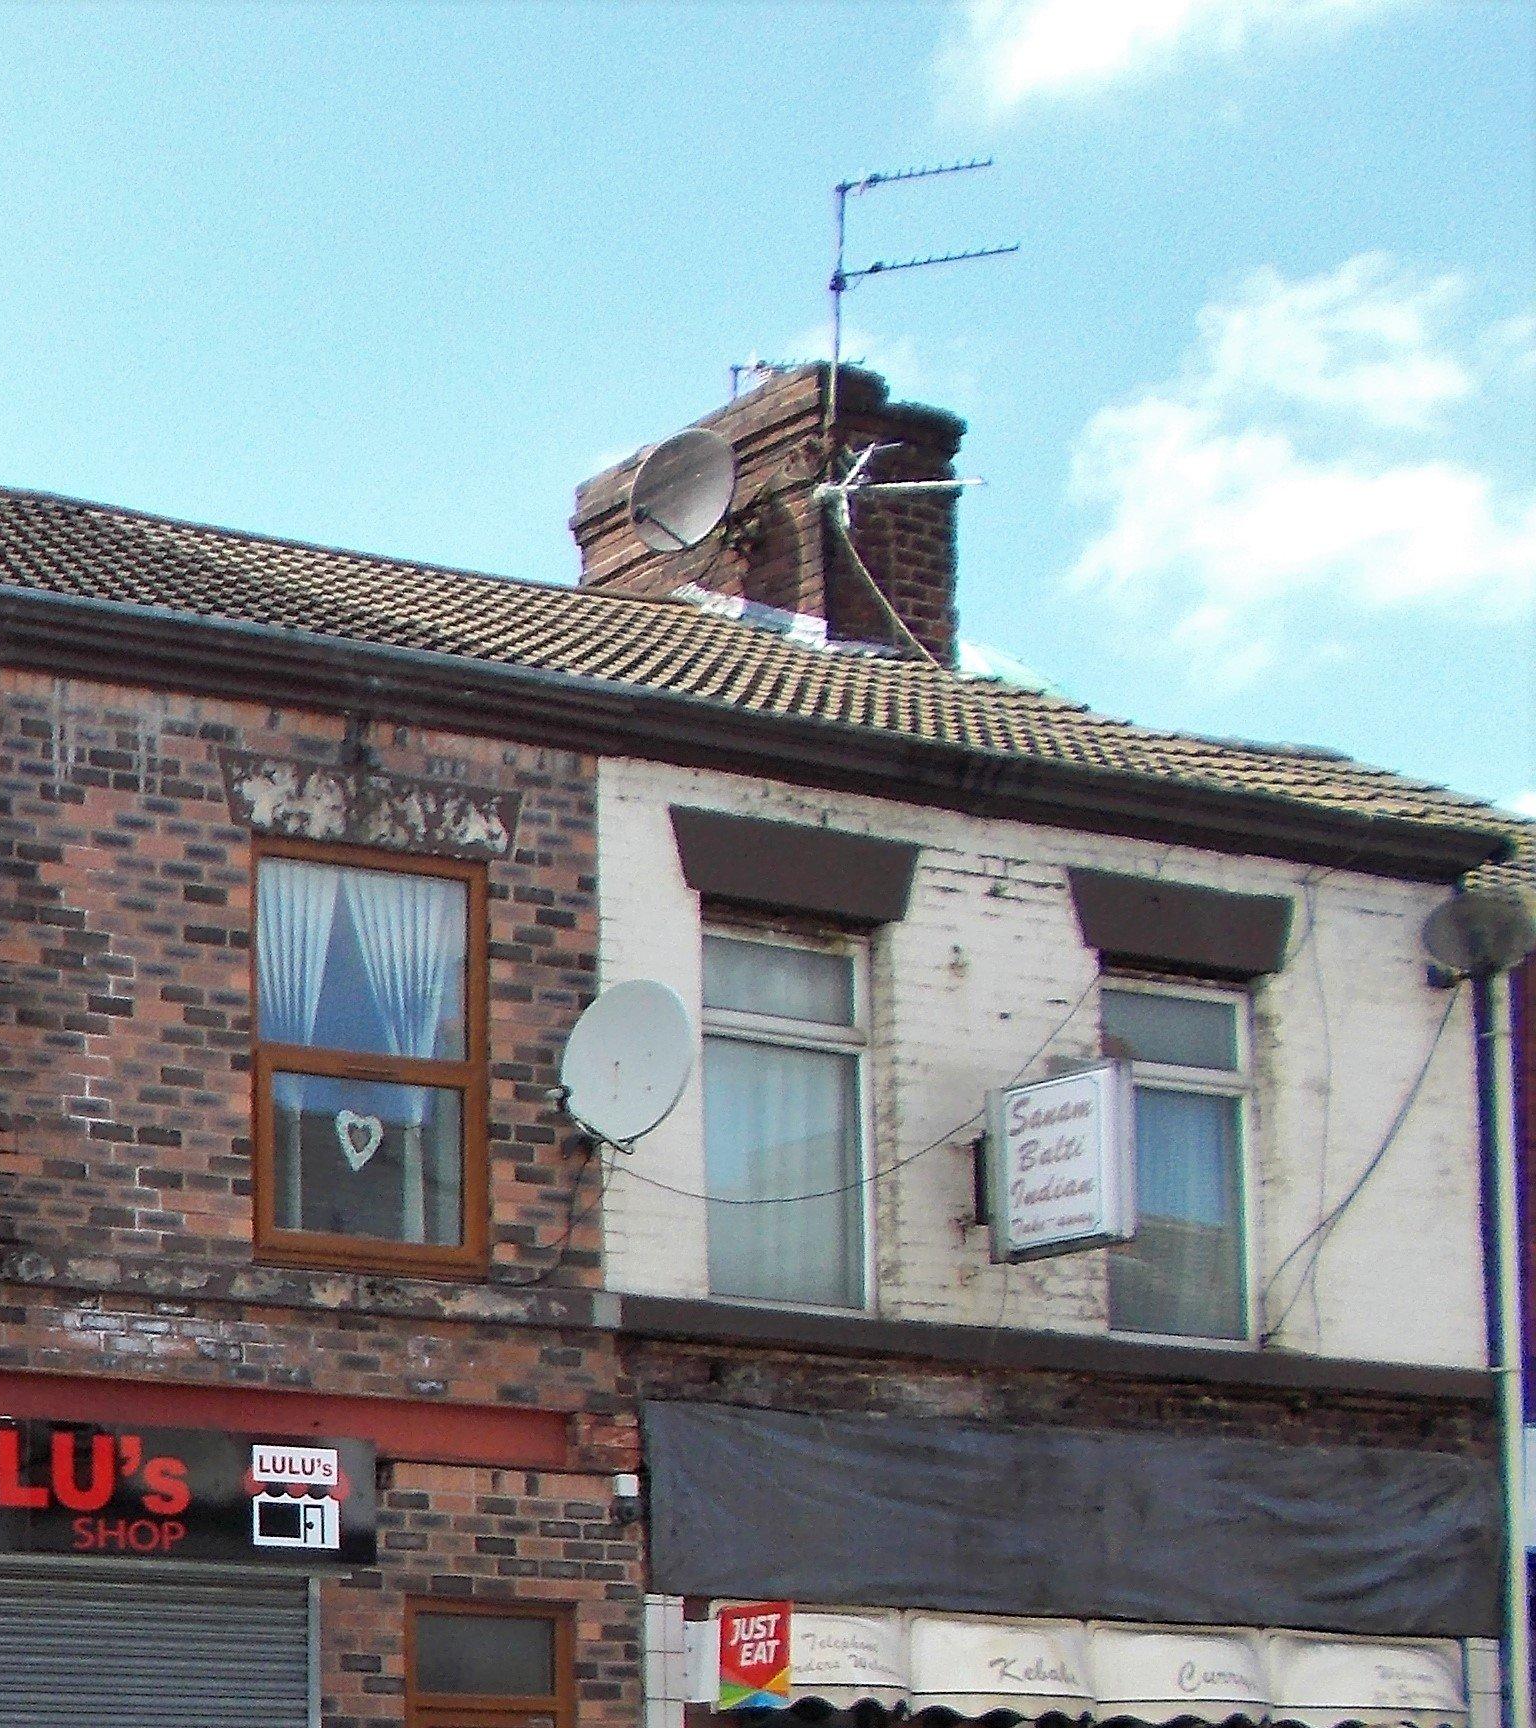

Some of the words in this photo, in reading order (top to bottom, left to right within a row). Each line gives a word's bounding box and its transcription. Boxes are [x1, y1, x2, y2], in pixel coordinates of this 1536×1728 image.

[1010, 1174, 1095, 1210] Indian
[259, 1454, 333, 1477] LULU's
[73, 1517, 185, 1552] SHOP
[730, 1613, 781, 1647] JUST
[740, 1639, 780, 1667] EAT
